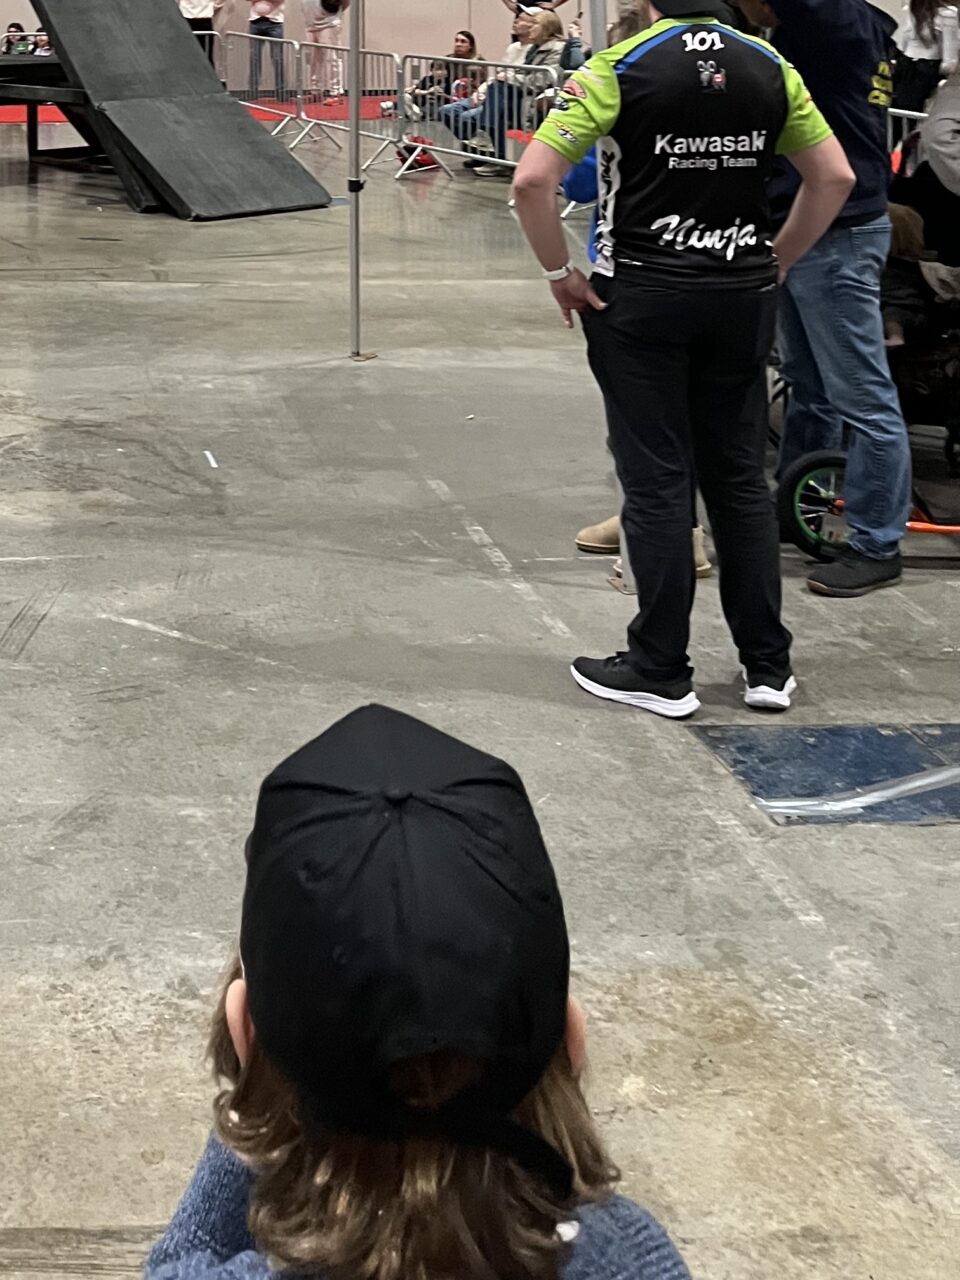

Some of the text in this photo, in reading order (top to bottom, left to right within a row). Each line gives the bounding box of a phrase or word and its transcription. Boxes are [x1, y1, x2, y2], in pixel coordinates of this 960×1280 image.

[681, 31, 725, 52] 101
[668, 155, 758, 171] Racing Team
[650, 214, 757, 261] Ninja
